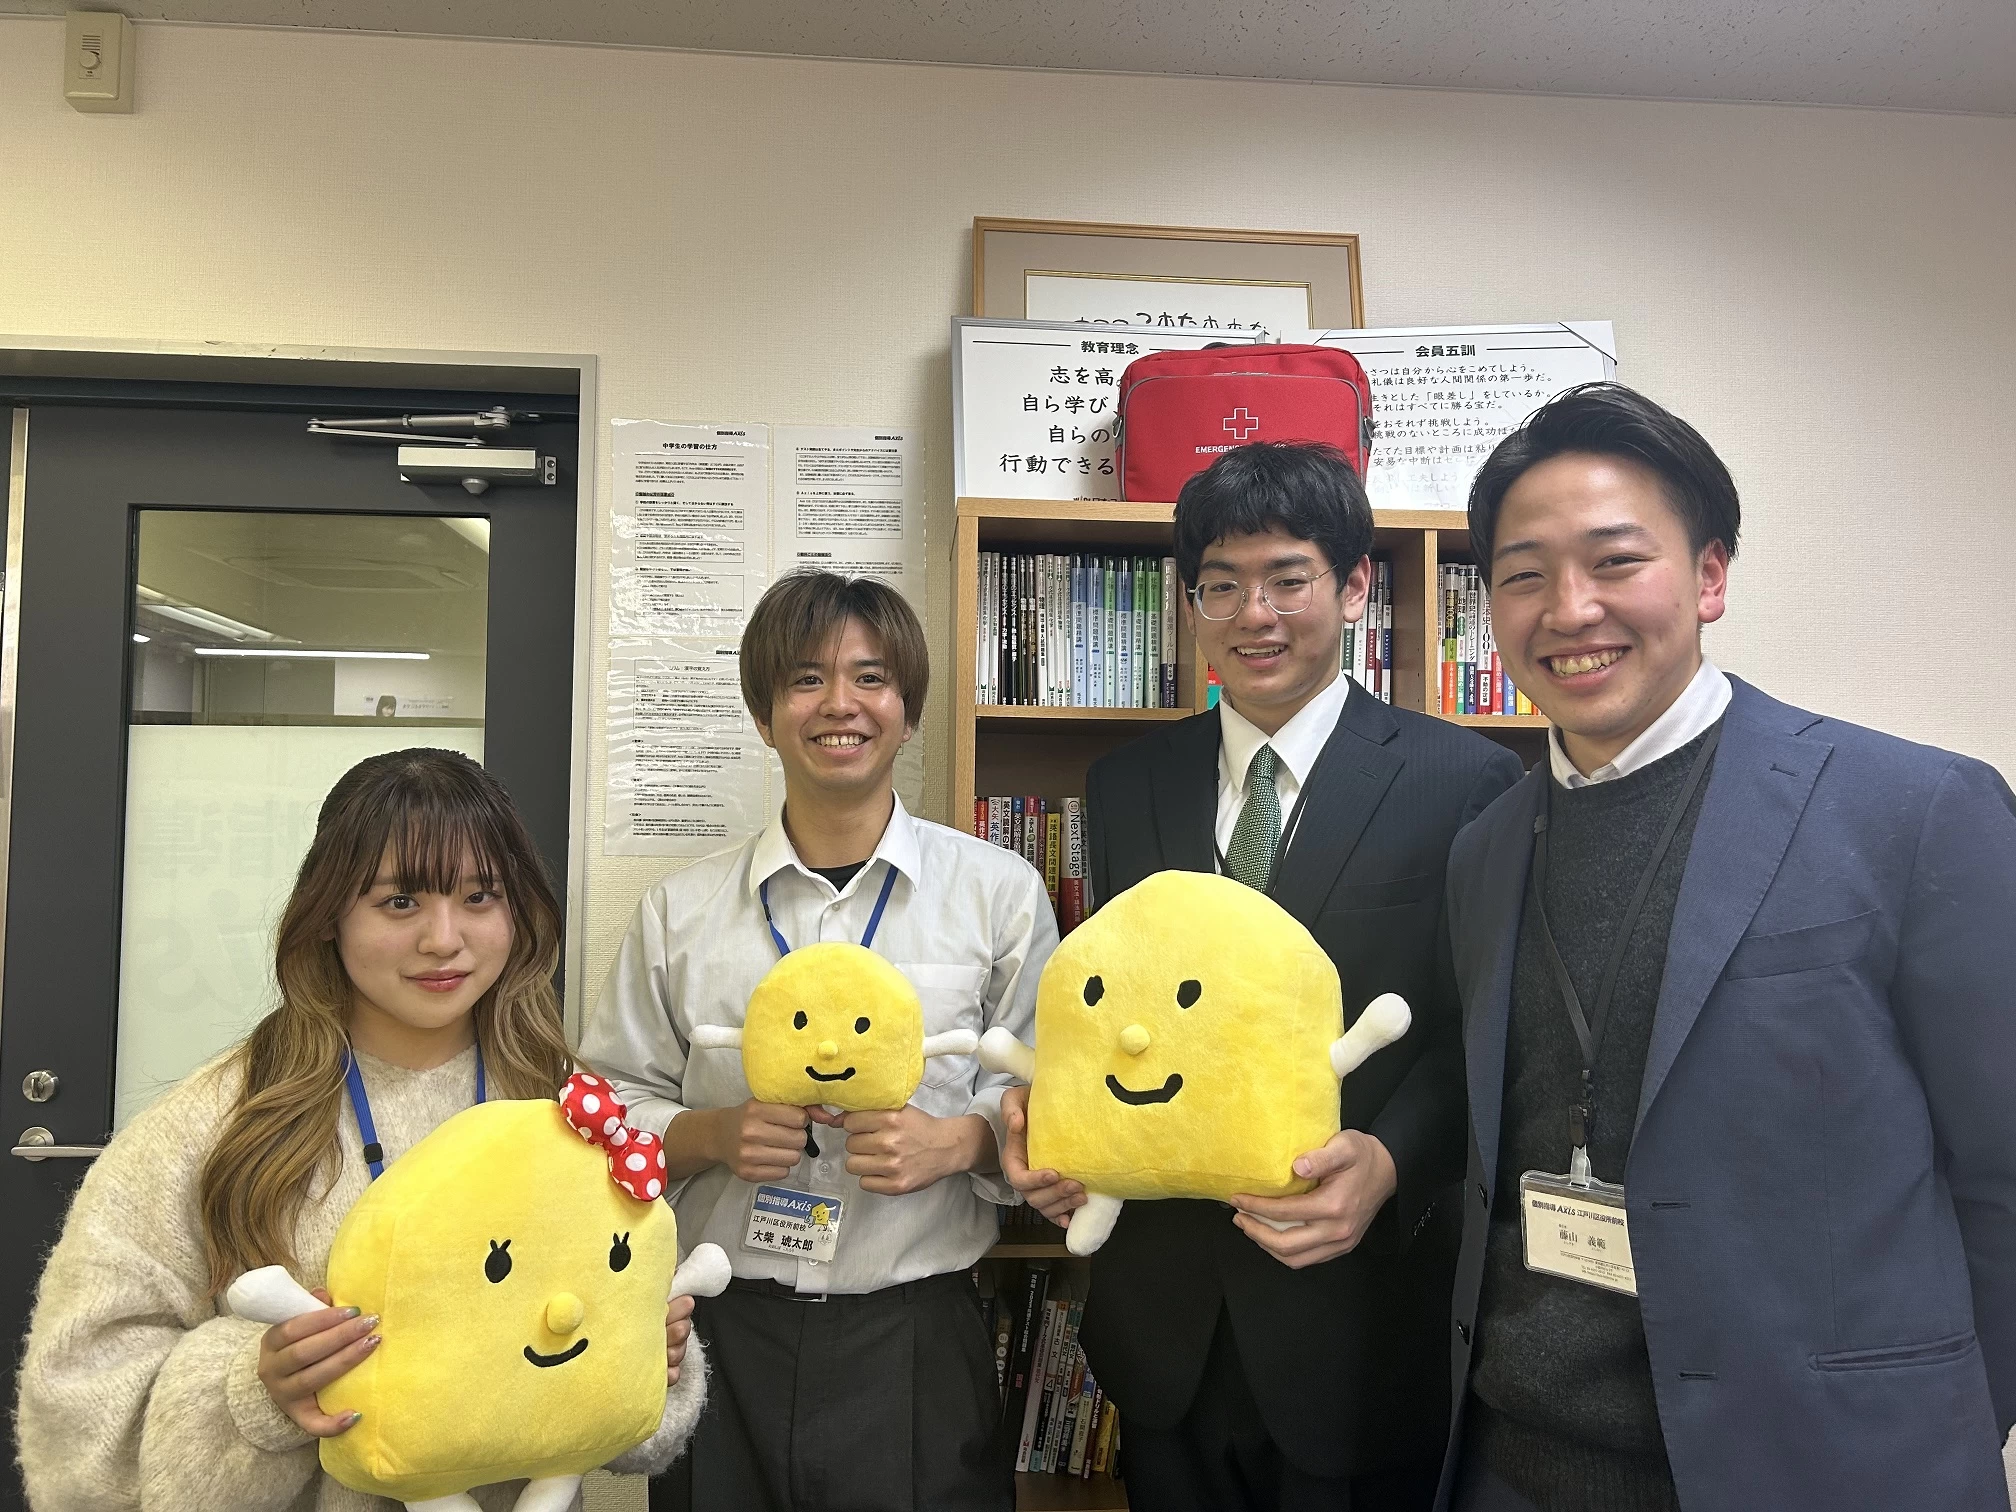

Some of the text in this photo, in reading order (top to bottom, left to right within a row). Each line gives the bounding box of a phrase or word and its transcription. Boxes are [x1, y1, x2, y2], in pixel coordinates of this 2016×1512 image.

[1081, 341, 1139, 354] 教育理念
[1415, 345, 1476, 357] 会員五訓
[1365, 364, 1535, 377] さつは自分から心をこめてしよう。
[1373, 401, 1502, 412] それはすべてに勝る宝だ。
[1049, 425, 1111, 444] 自らの
[1000, 454, 1114, 475] 行動できる
[1069, 814, 1082, 877] Next Stage
